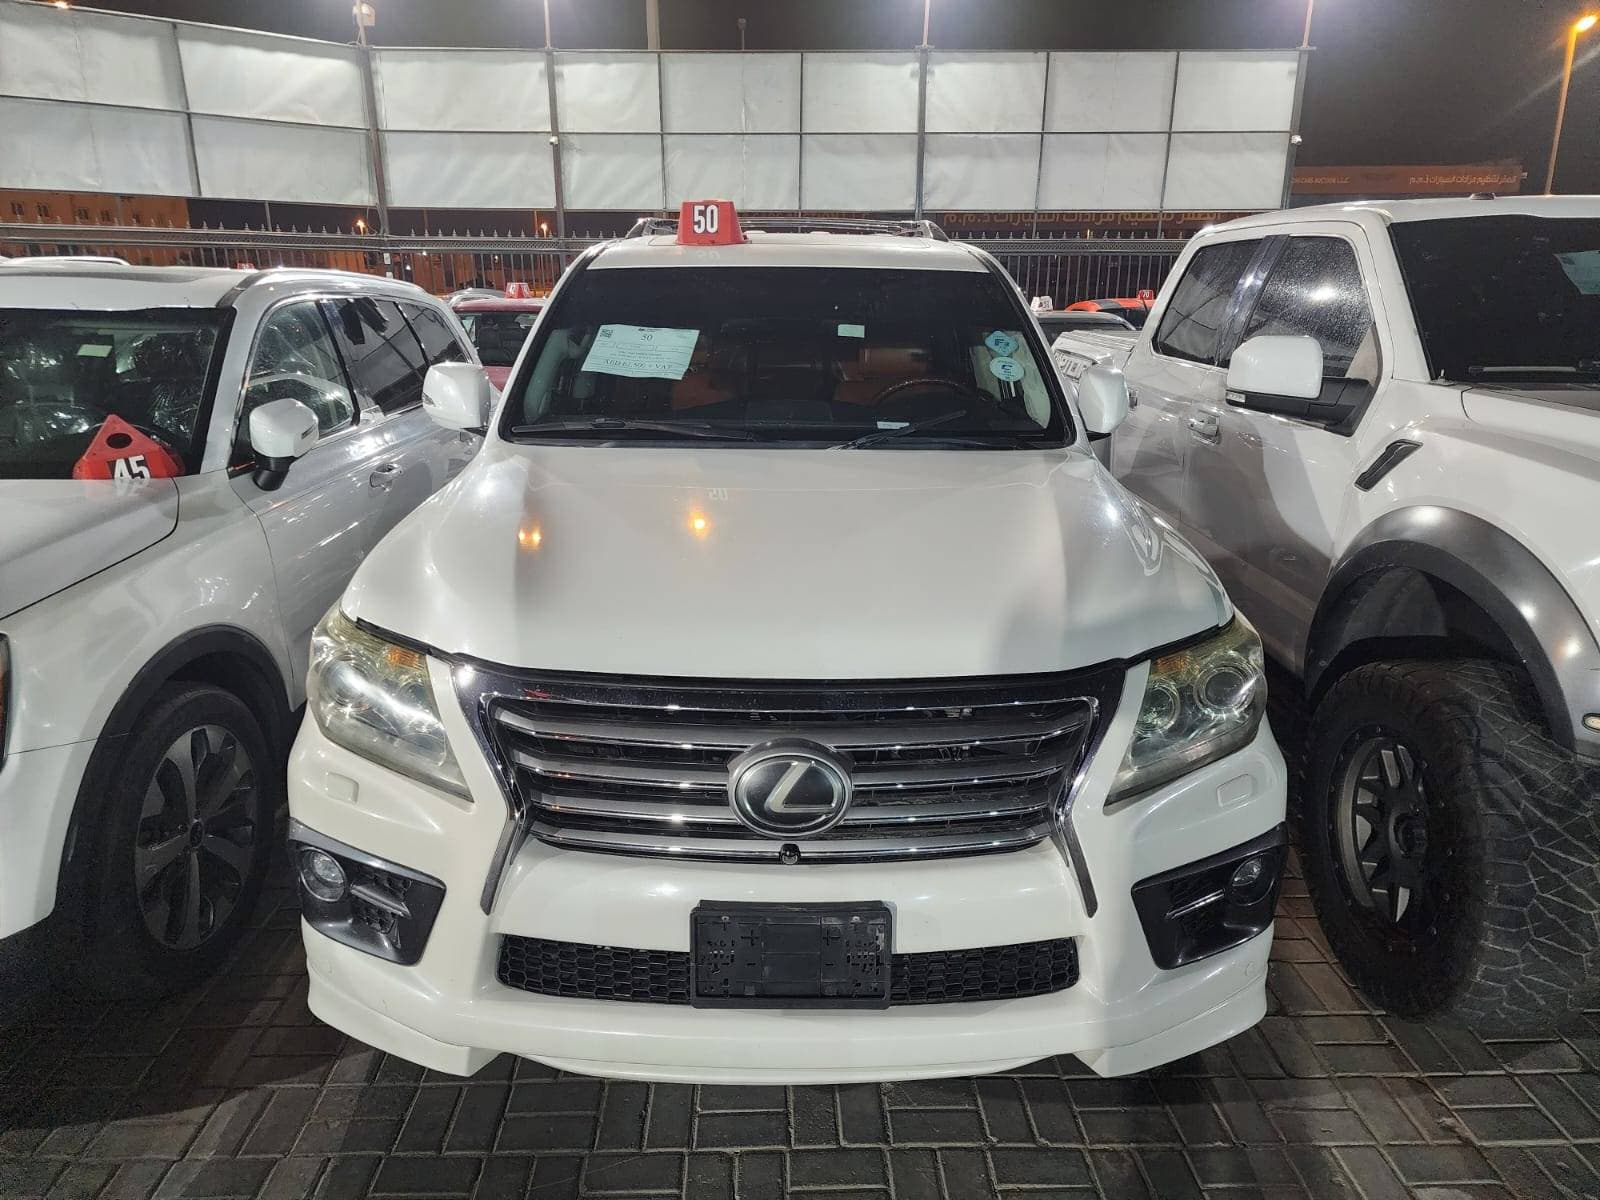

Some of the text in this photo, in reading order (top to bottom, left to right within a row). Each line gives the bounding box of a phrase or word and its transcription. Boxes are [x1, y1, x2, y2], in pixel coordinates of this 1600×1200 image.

[693, 204, 719, 234] 50
[641, 333, 653, 342] 50
[113, 455, 151, 480] 45
